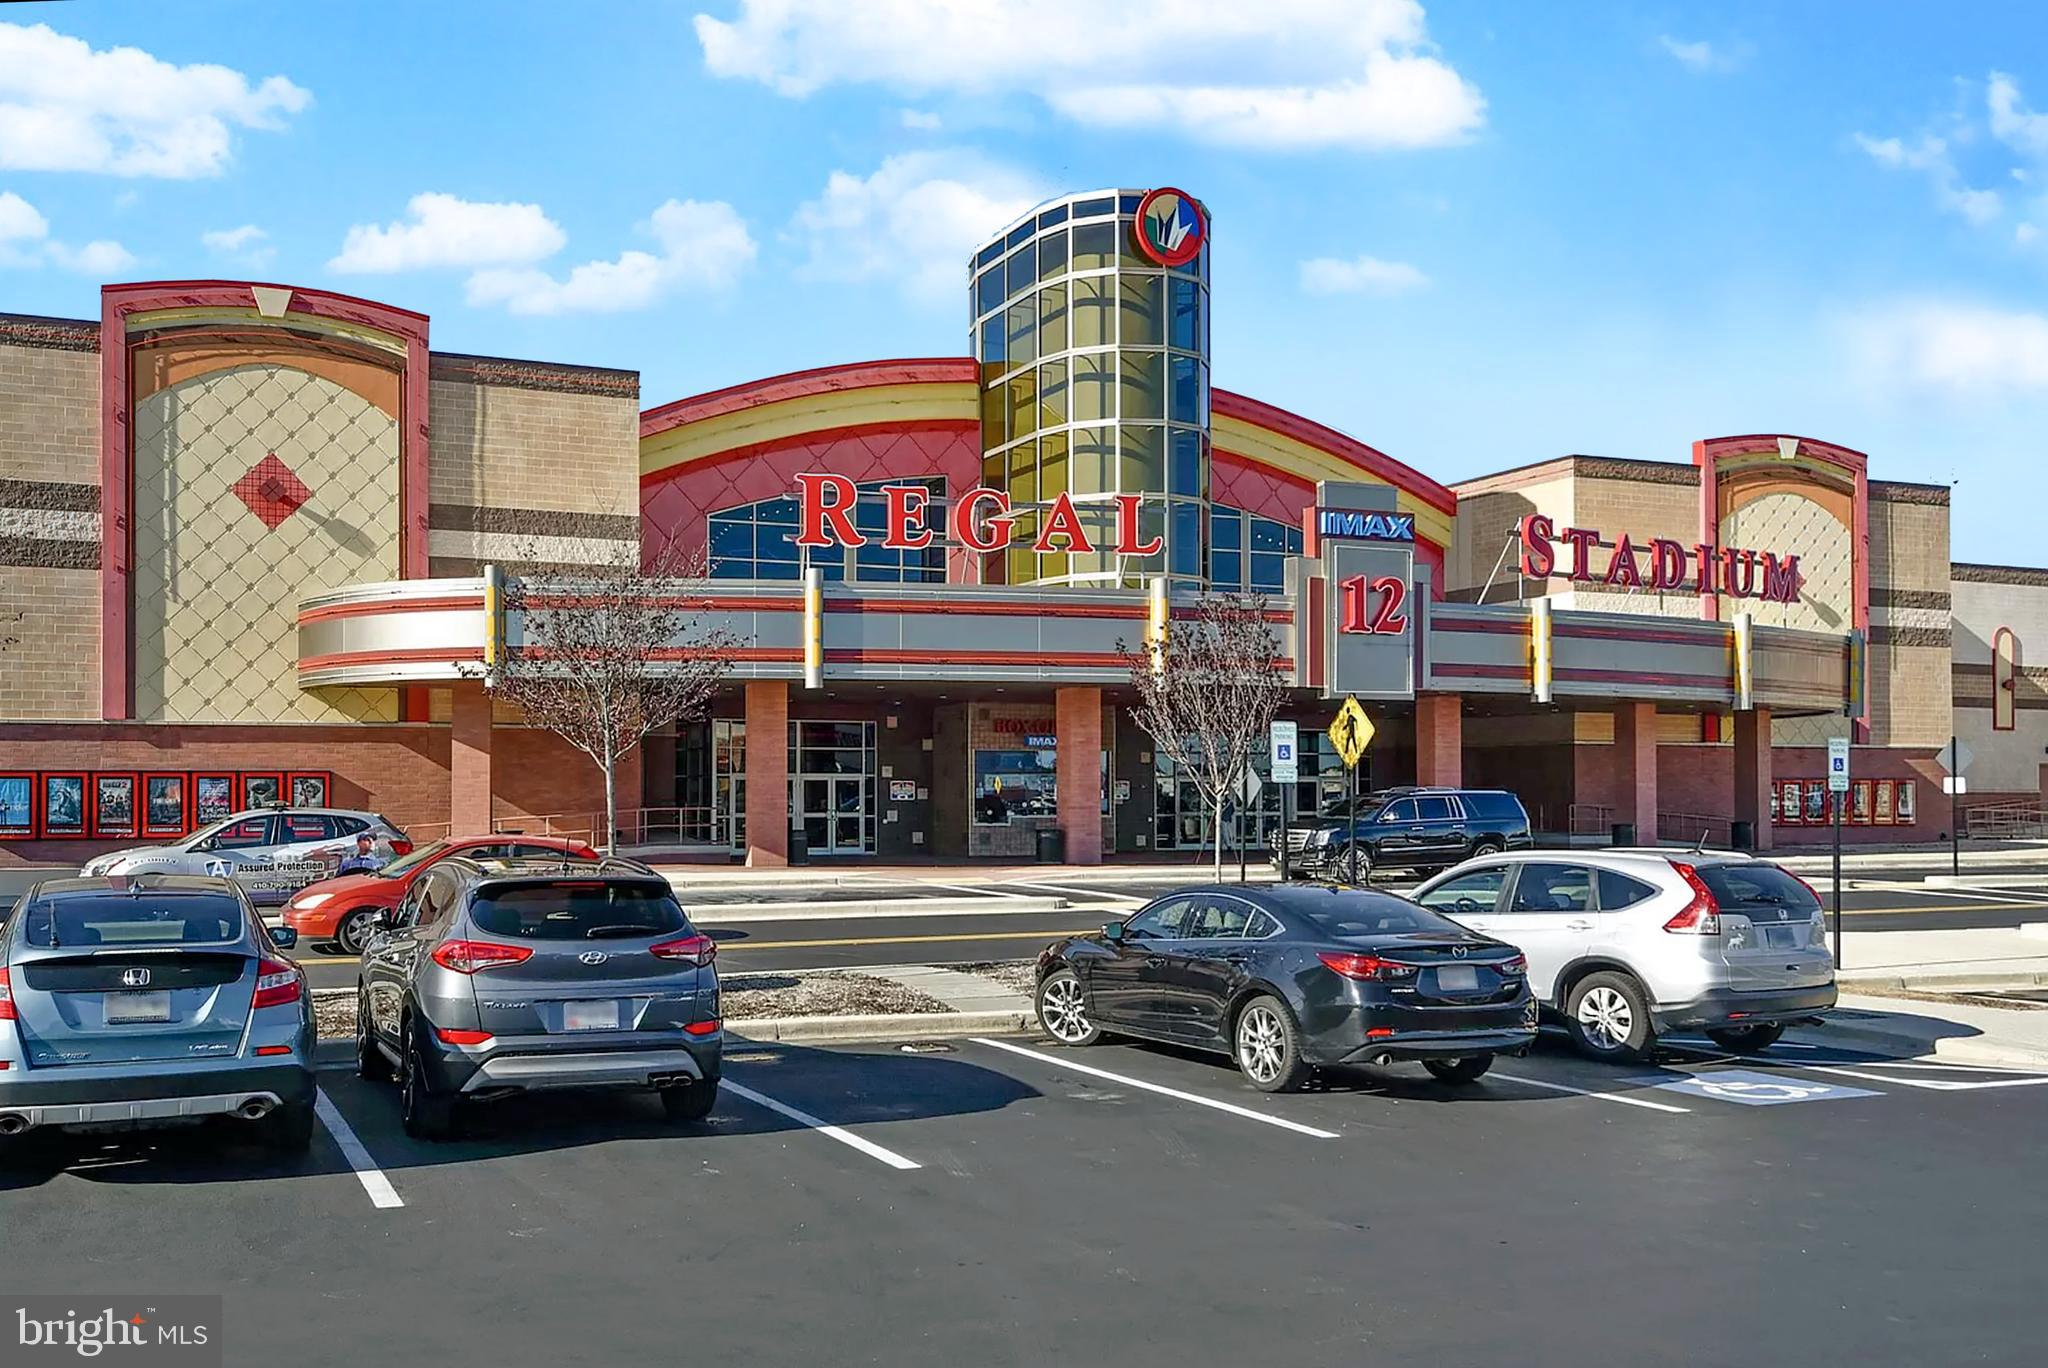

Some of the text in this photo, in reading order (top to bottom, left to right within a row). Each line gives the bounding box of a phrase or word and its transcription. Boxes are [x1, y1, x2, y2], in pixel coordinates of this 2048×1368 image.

[795, 473, 1163, 556] REGAL
[1321, 511, 1413, 539] IMAX
[1521, 513, 1805, 603] STADIUM
[1340, 574, 1408, 635] 12
[238, 861, 324, 872] Assured Protection
